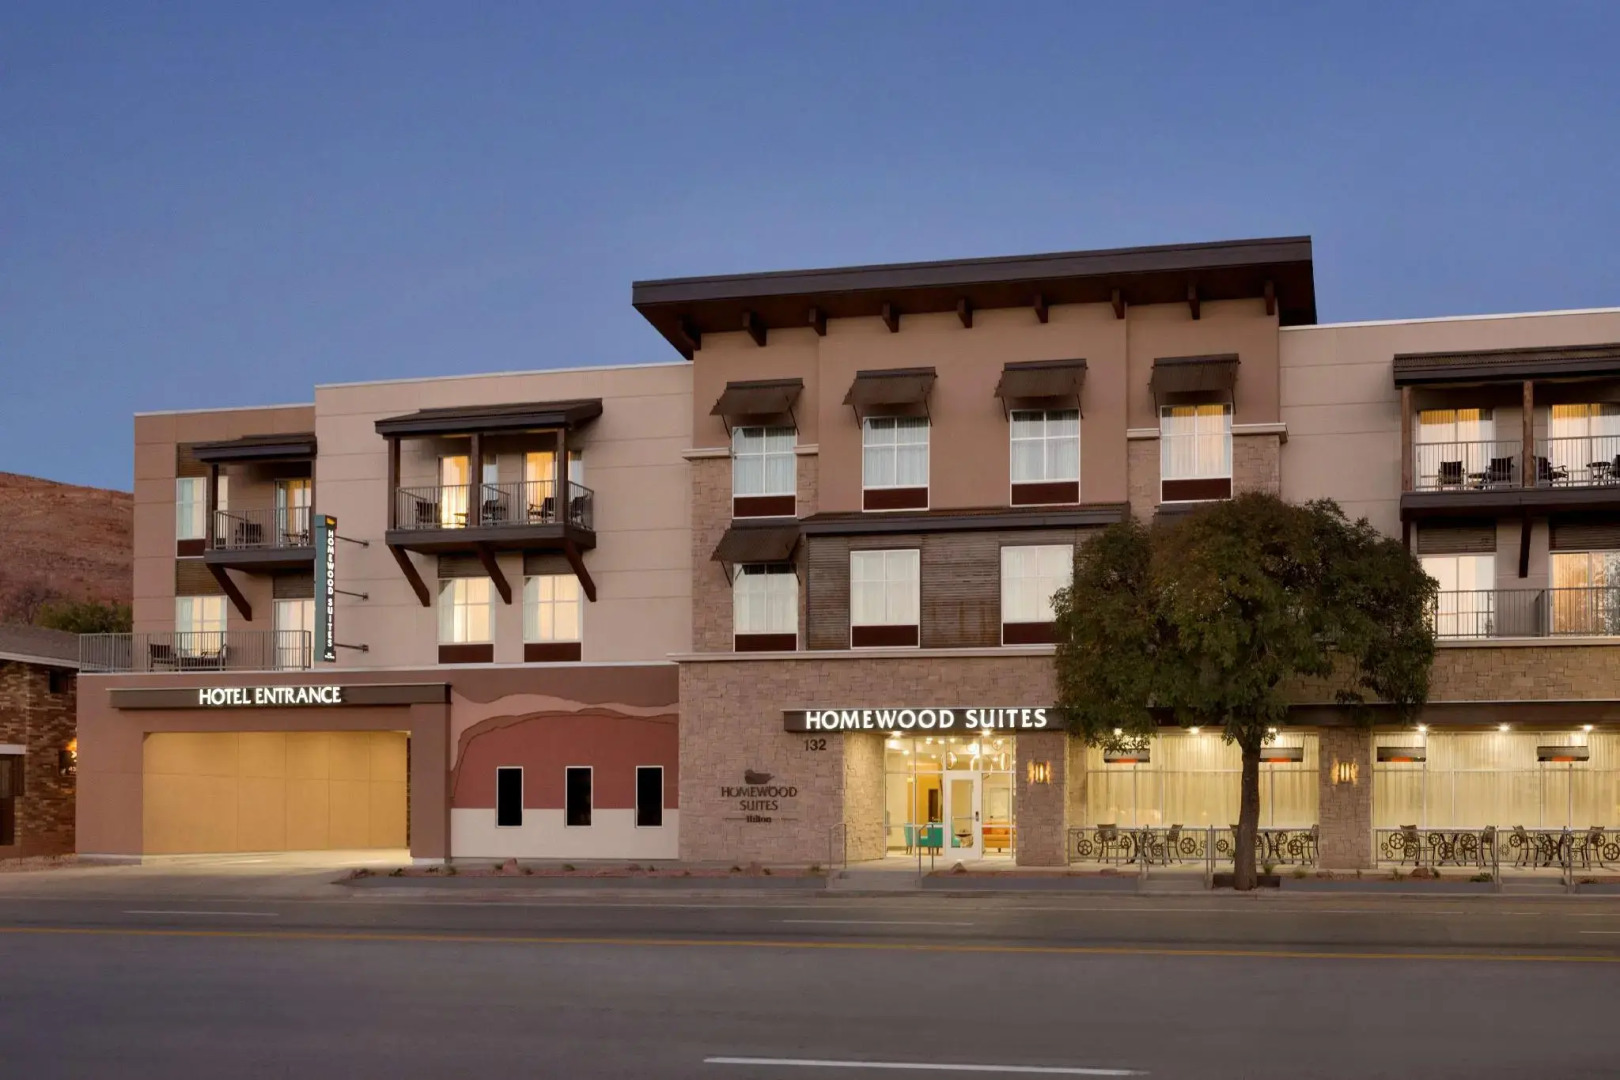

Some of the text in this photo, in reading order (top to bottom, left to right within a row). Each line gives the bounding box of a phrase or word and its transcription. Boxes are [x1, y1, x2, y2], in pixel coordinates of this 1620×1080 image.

[327, 529, 335, 595] HOMEWOOD
[199, 686, 342, 705] HOTEL ENTRANCE
[805, 708, 1048, 730] HOMEWOOD SUITES
[804, 738, 827, 751] 132
[721, 786, 798, 798] HOMEWOOD
[740, 800, 779, 811] SUITES
